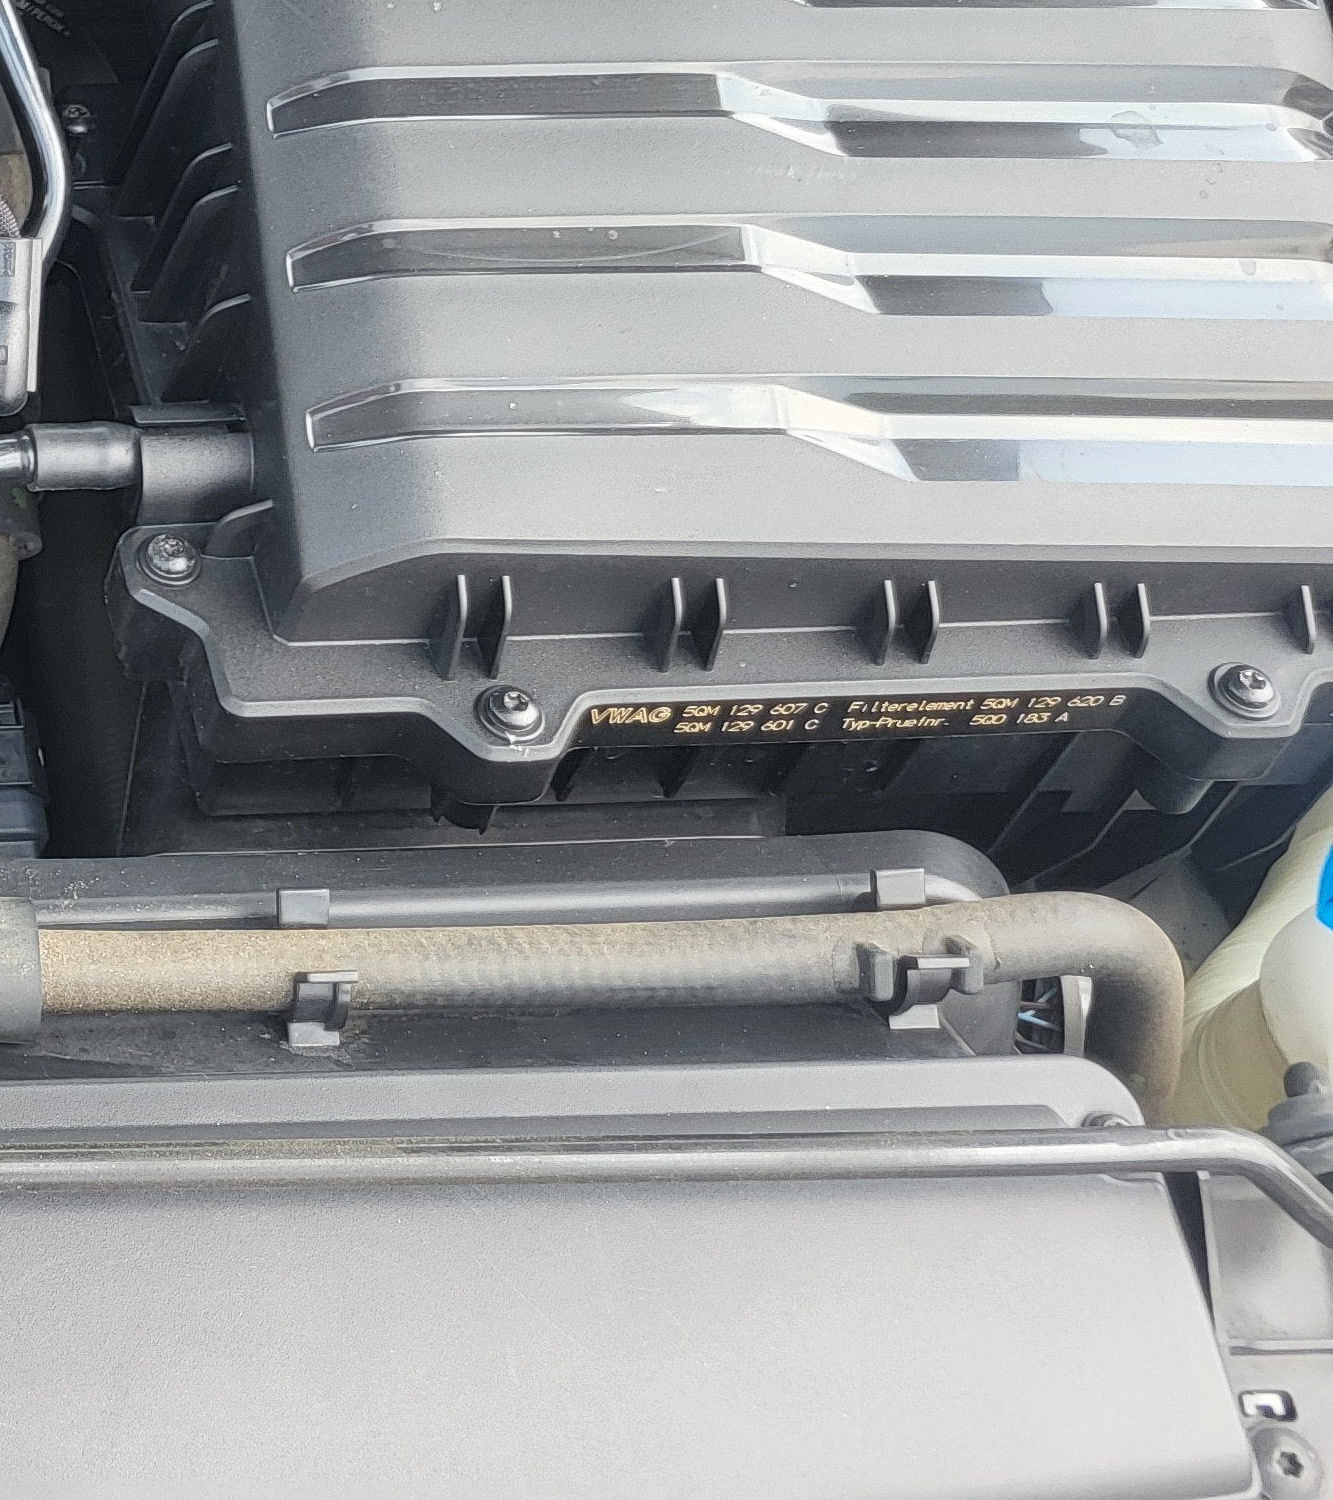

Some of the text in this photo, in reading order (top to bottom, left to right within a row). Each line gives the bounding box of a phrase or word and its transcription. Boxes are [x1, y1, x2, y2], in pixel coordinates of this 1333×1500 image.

[729, 704, 764, 717] 129
[769, 703, 808, 716] 607
[814, 702, 830, 714] C
[847, 698, 975, 713] Filterelement
[1027, 695, 1062, 709] 129
[1067, 694, 1105, 708] 620
[1109, 694, 1127, 706] B
[720, 719, 755, 732] 129
[760, 719, 794, 732] 601
[803, 718, 820, 731] C
[1016, 712, 1051, 725] 183
[1054, 711, 1070, 723] A
